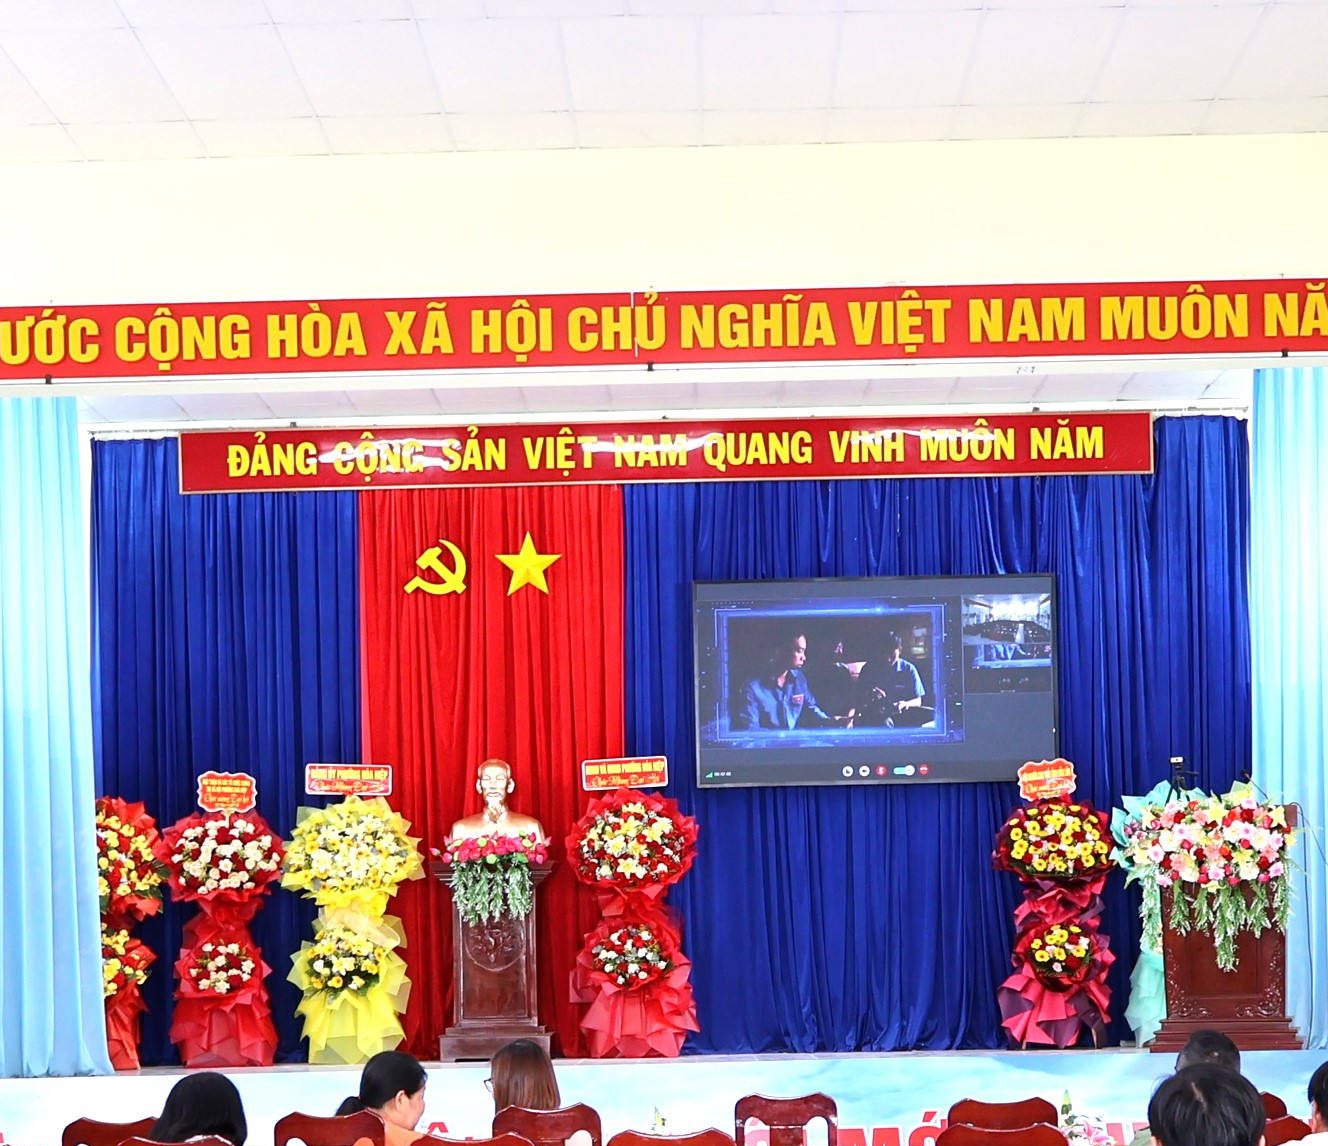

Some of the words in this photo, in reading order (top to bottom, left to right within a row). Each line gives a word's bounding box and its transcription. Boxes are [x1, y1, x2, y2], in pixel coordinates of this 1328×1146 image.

[116, 308, 251, 371] CỘNG
[268, 302, 366, 359] HÒA
[382, 301, 450, 357] XÃ
[471, 301, 552, 362] HỘI
[567, 291, 666, 351] CHỦ
[681, 292, 835, 350] NGHĨA
[847, 291, 952, 353] VIỆT
[969, 296, 1085, 343] NAM
[1099, 285, 1249, 340] MUÔN
[227, 431, 317, 477] ĐẢNG
[333, 431, 424, 482] CỘNG
[443, 426, 506, 471] SẢN
[523, 427, 597, 477] VIỆT
[614, 434, 687, 467] NAM
[703, 432, 813, 472] QUANG
[829, 428, 904, 464] VINH
[921, 418, 1015, 462] MUÔN
[1030, 420, 1103, 459] NĂM
